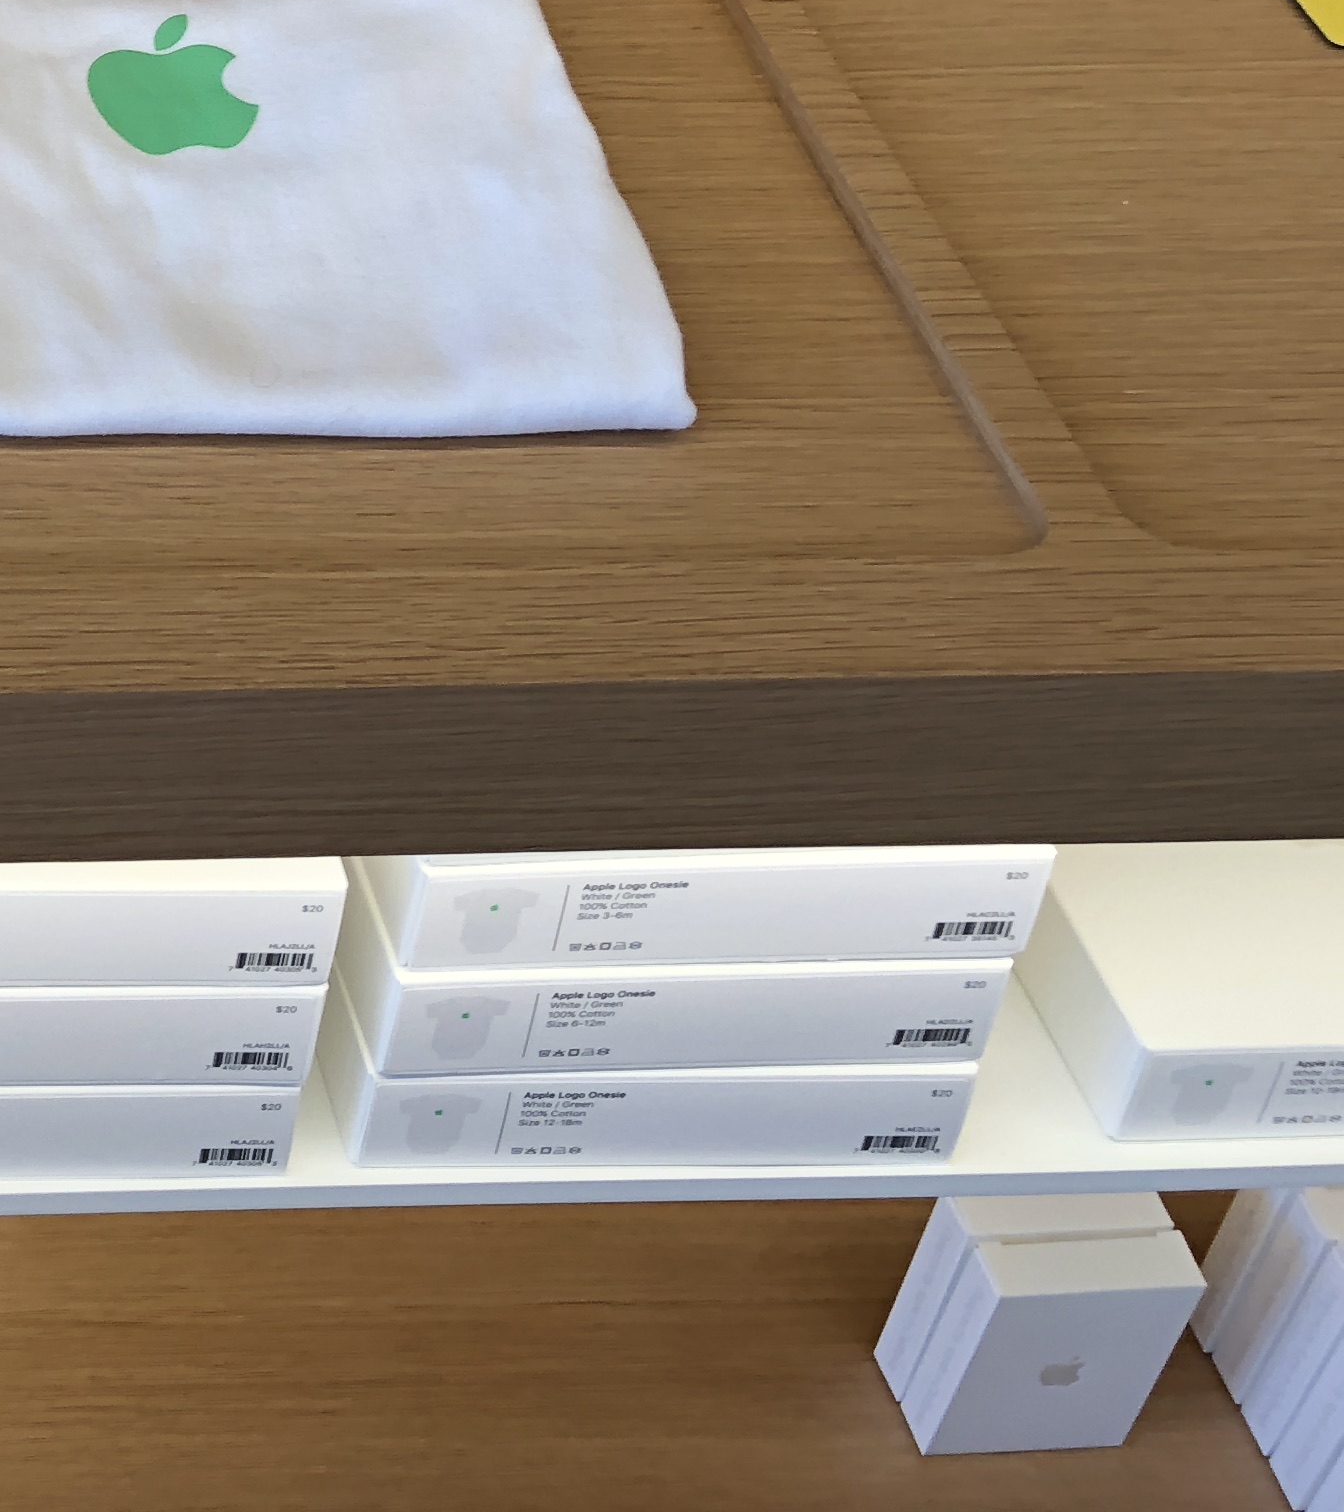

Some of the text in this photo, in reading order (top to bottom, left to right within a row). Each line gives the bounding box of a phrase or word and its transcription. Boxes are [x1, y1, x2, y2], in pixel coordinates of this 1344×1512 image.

[1006, 872, 1030, 880] $20
[582, 881, 690, 892] Apple Logo Onesie
[581, 893, 613, 901] White
[622, 891, 656, 900] Green
[302, 905, 324, 913] $20
[577, 912, 600, 920] Size
[963, 980, 987, 989] $20
[552, 990, 656, 1000] Apple Logo Onesie
[550, 1001, 581, 1009] White
[590, 1000, 624, 1008] Green
[275, 1005, 298, 1014] $20
[578, 1010, 616, 1018] Cotton
[546, 1020, 569, 1028] Size
[524, 1091, 626, 1100] Apple Logo Onesie
[931, 1089, 953, 1098] $20
[261, 1103, 282, 1111] $20
[562, 1100, 594, 1108] Green
